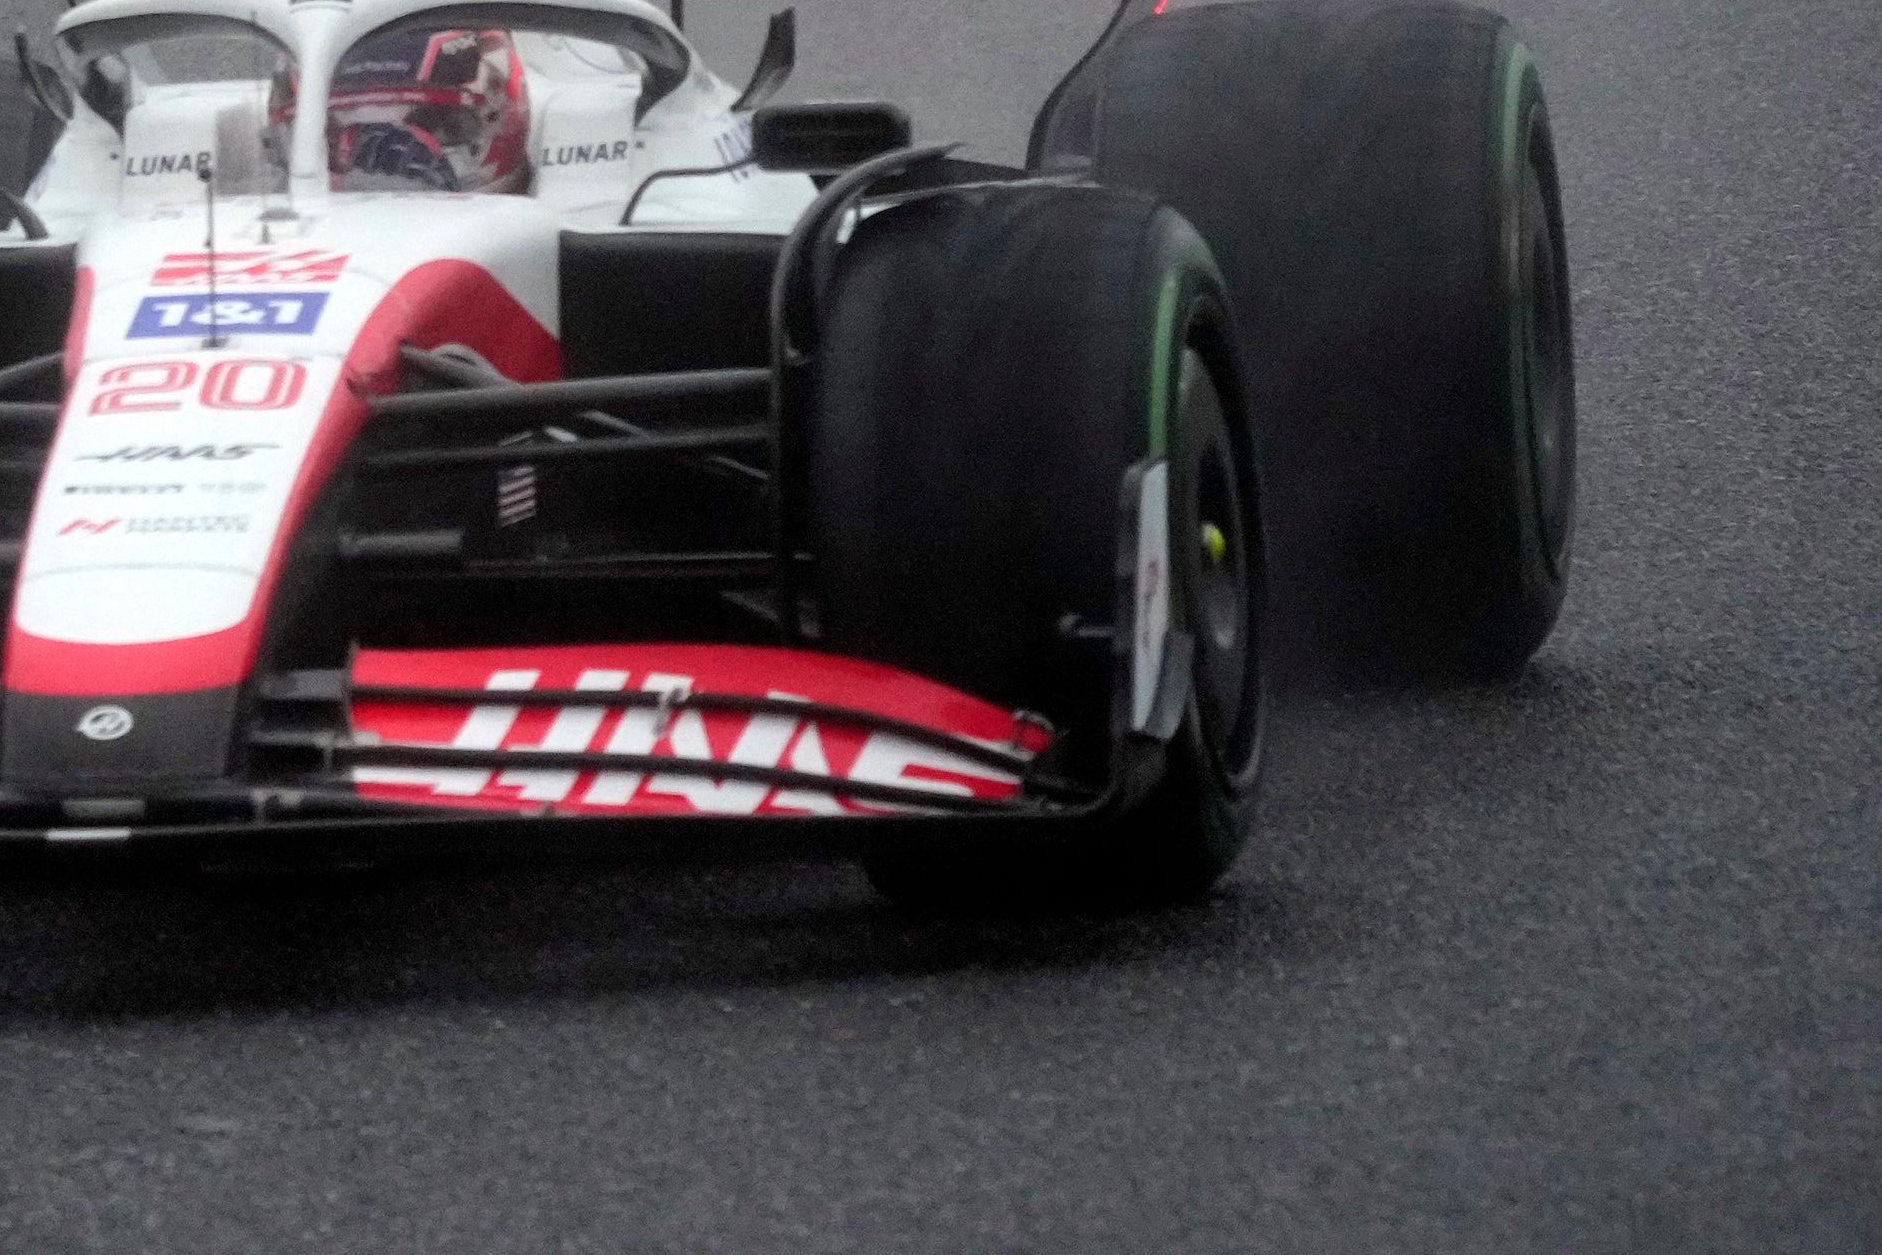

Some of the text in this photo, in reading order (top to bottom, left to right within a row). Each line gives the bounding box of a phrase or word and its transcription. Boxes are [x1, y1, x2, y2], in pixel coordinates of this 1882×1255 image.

[543, 139, 627, 167] LUNAR
[153, 299, 305, 327] 1&1
[87, 359, 309, 416] 20
